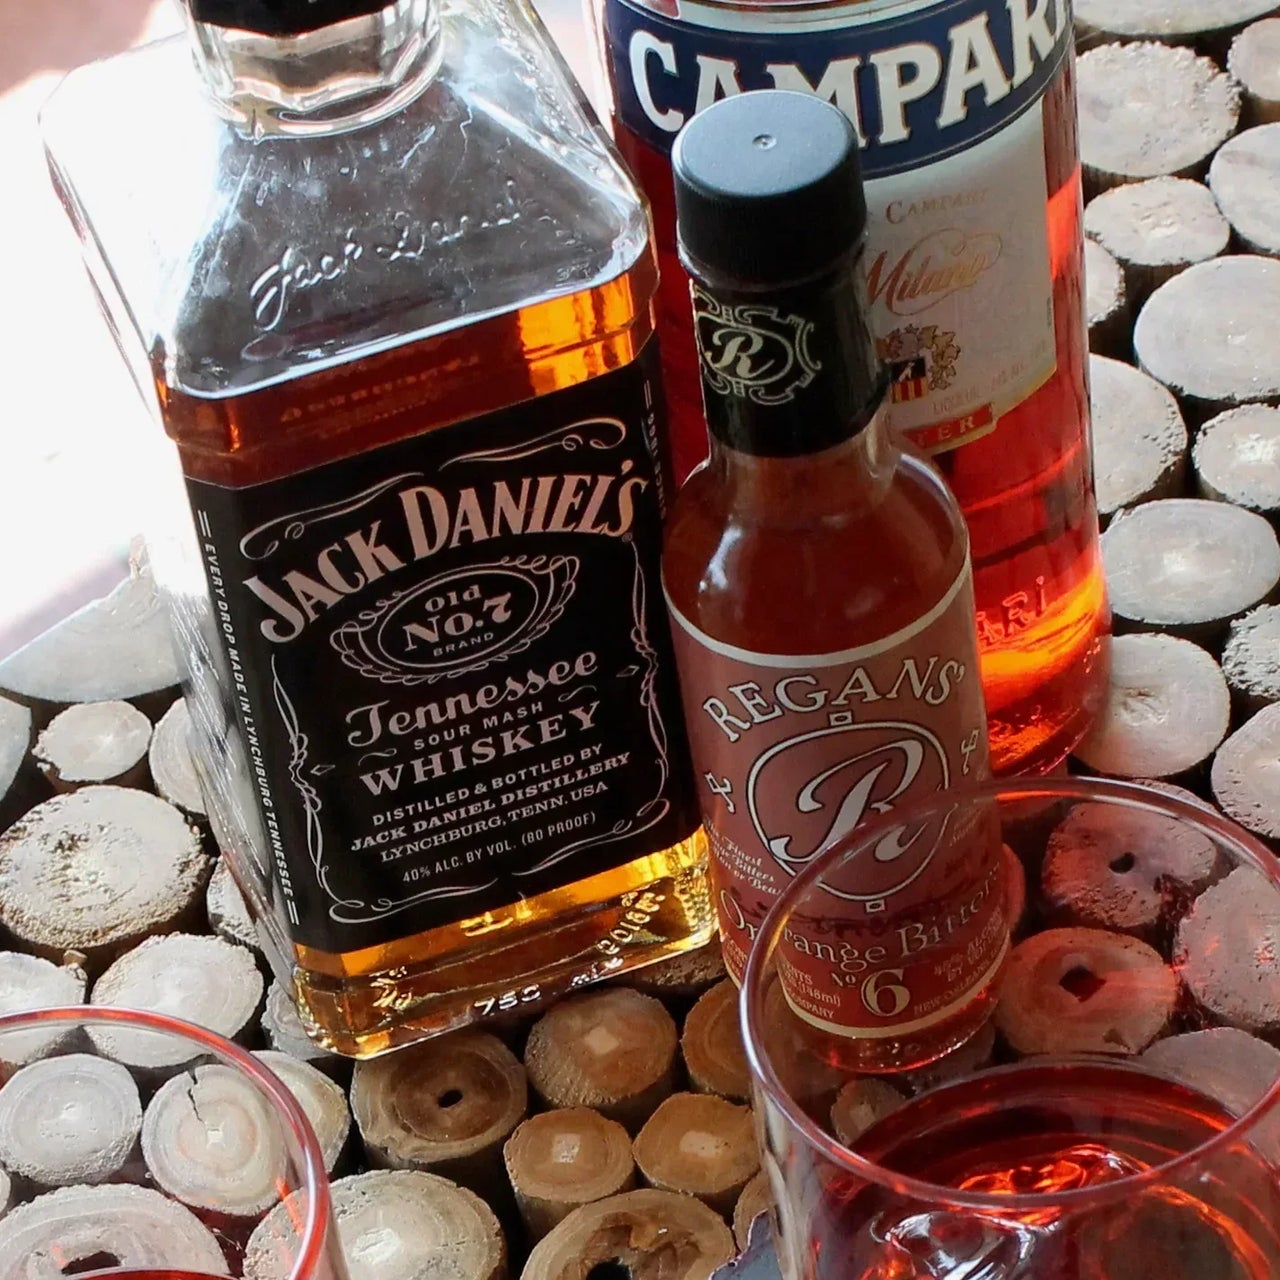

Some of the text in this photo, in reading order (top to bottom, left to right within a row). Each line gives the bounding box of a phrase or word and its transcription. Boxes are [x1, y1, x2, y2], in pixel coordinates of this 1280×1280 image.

[242, 459, 649, 644] JACK DANIEL'S
[424, 584, 481, 613] Old
[432, 632, 494, 657] BRAND
[204, 542, 294, 898] EVERY DROP MADE IN LYNCHBURG TENNESSEE
[345, 651, 598, 747] Tennessee
[413, 701, 544, 750] SOUR MASH
[359, 700, 601, 797] WHISKEY
[372, 743, 603, 826] DISTILLED & BOTTLED BY
[351, 752, 631, 851] JACK DANIEL DISTILLERY
[508, 794, 569, 823] TENN.
[571, 780, 609, 802] USA
[402, 865, 431, 884] 40%
[434, 855, 464, 874] ALC.
[466, 847, 483, 864] BY
[485, 838, 517, 858] VOL.
[547, 811, 597, 838] PROOF)
[861, 968, 911, 1018] 6
